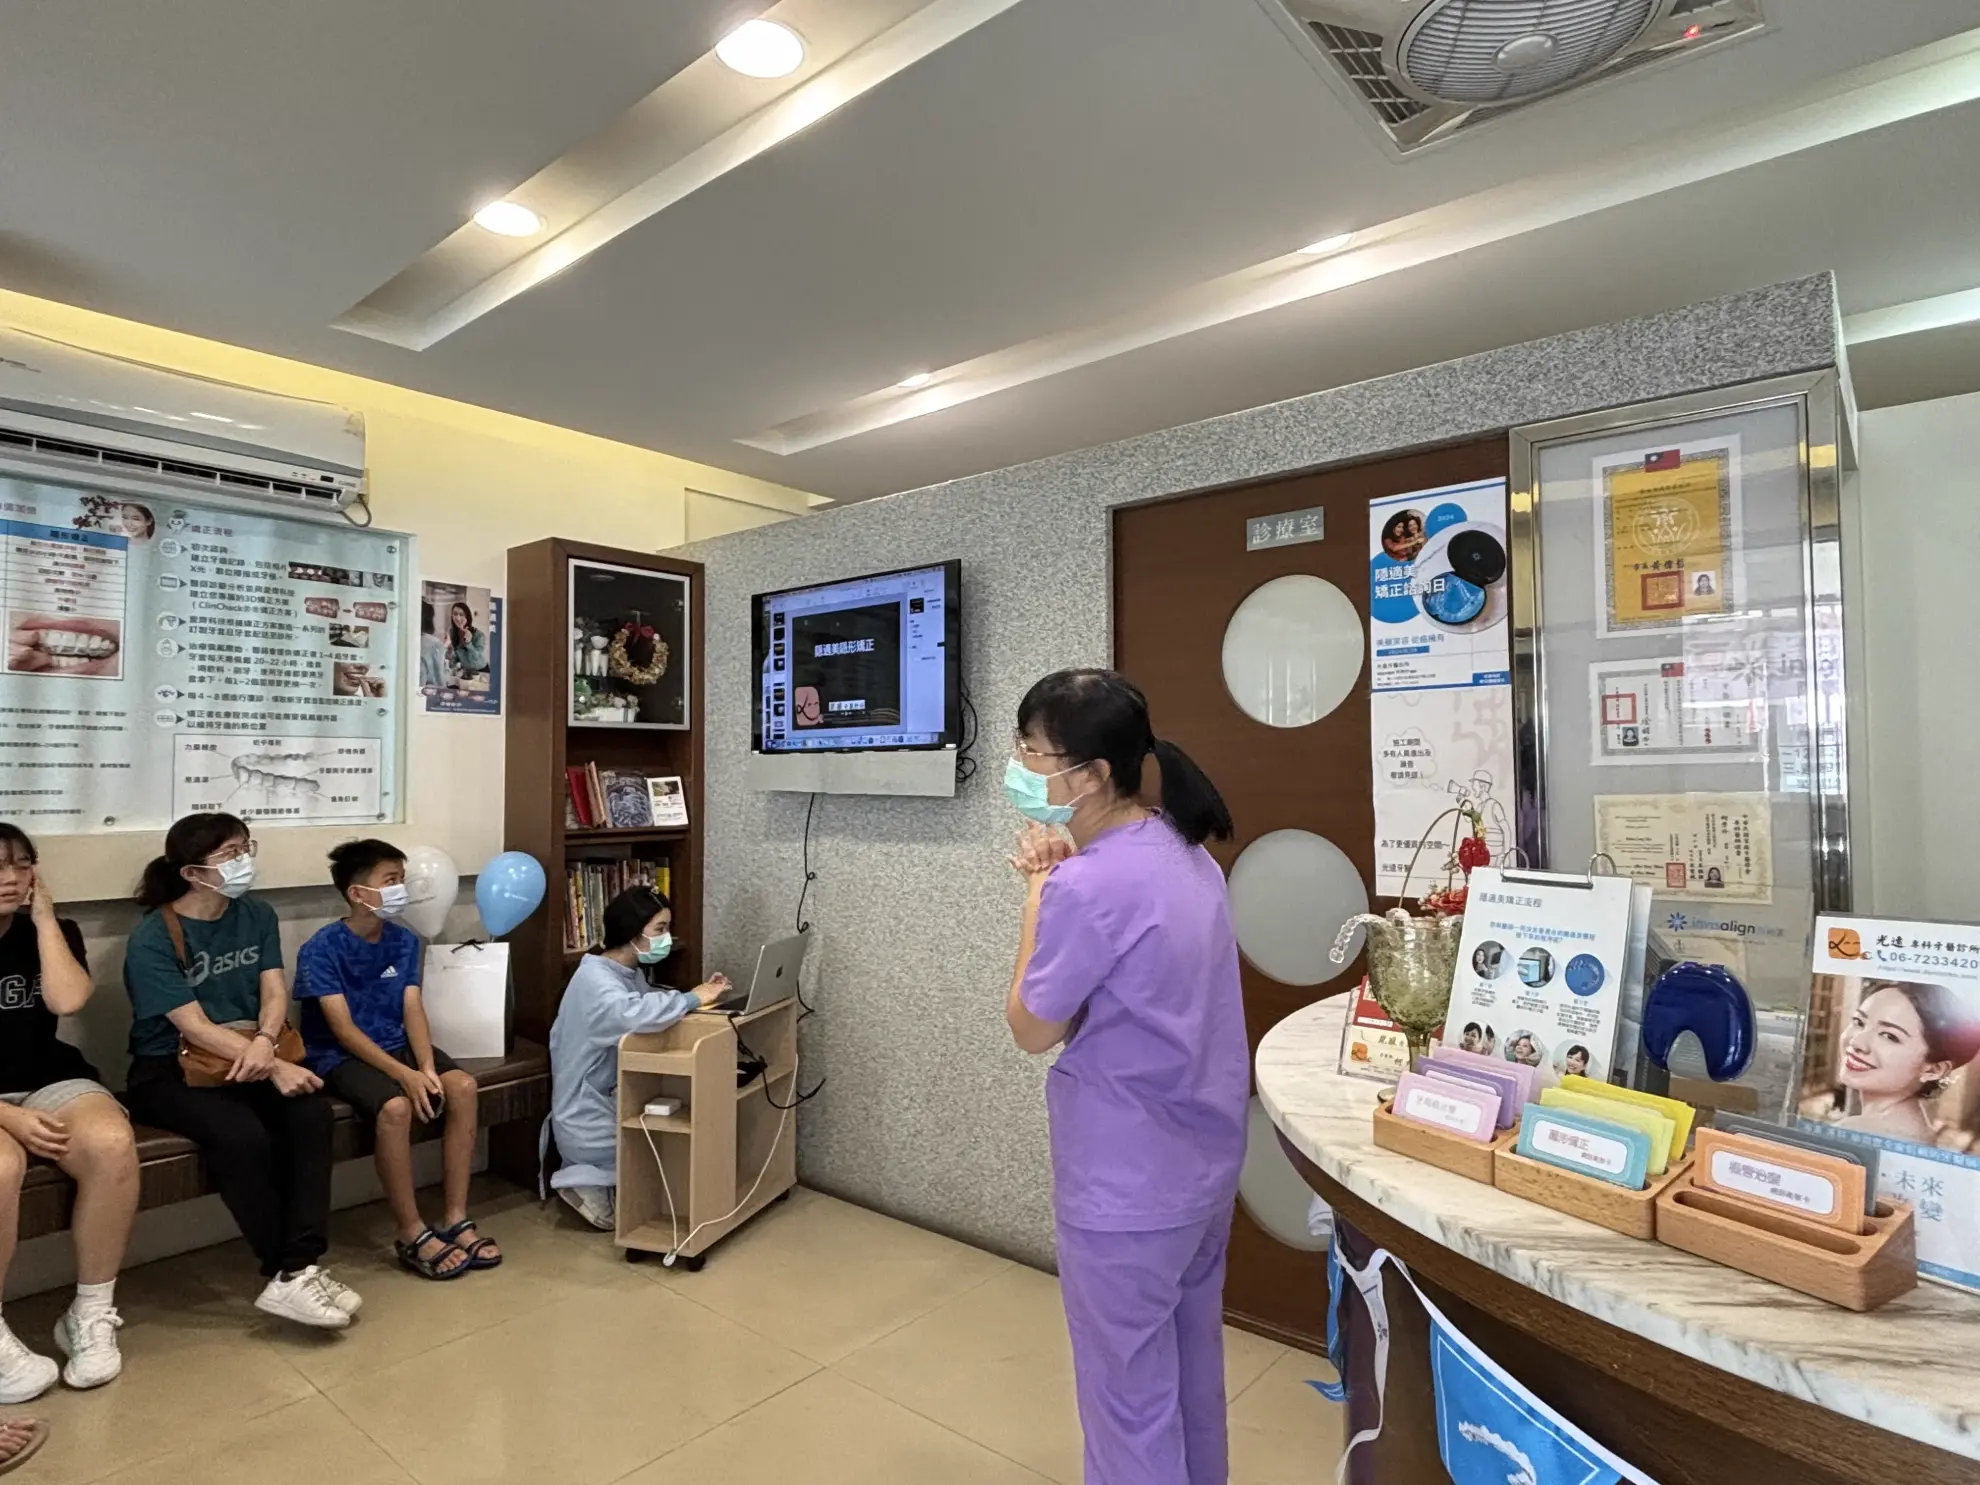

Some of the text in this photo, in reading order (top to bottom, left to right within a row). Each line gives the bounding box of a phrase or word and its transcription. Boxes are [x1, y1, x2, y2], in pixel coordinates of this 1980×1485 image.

[1252, 514, 1320, 545] 診療室
[1375, 564, 1417, 582] 隱適美
[1375, 578, 1446, 599] 矯正諮詢日
[814, 638, 875, 658] 隱適美隱形矯正
[212, 945, 261, 975] asics
[1890, 952, 1979, 969] 06-7233420
[1895, 1170, 1944, 1196] 未來
